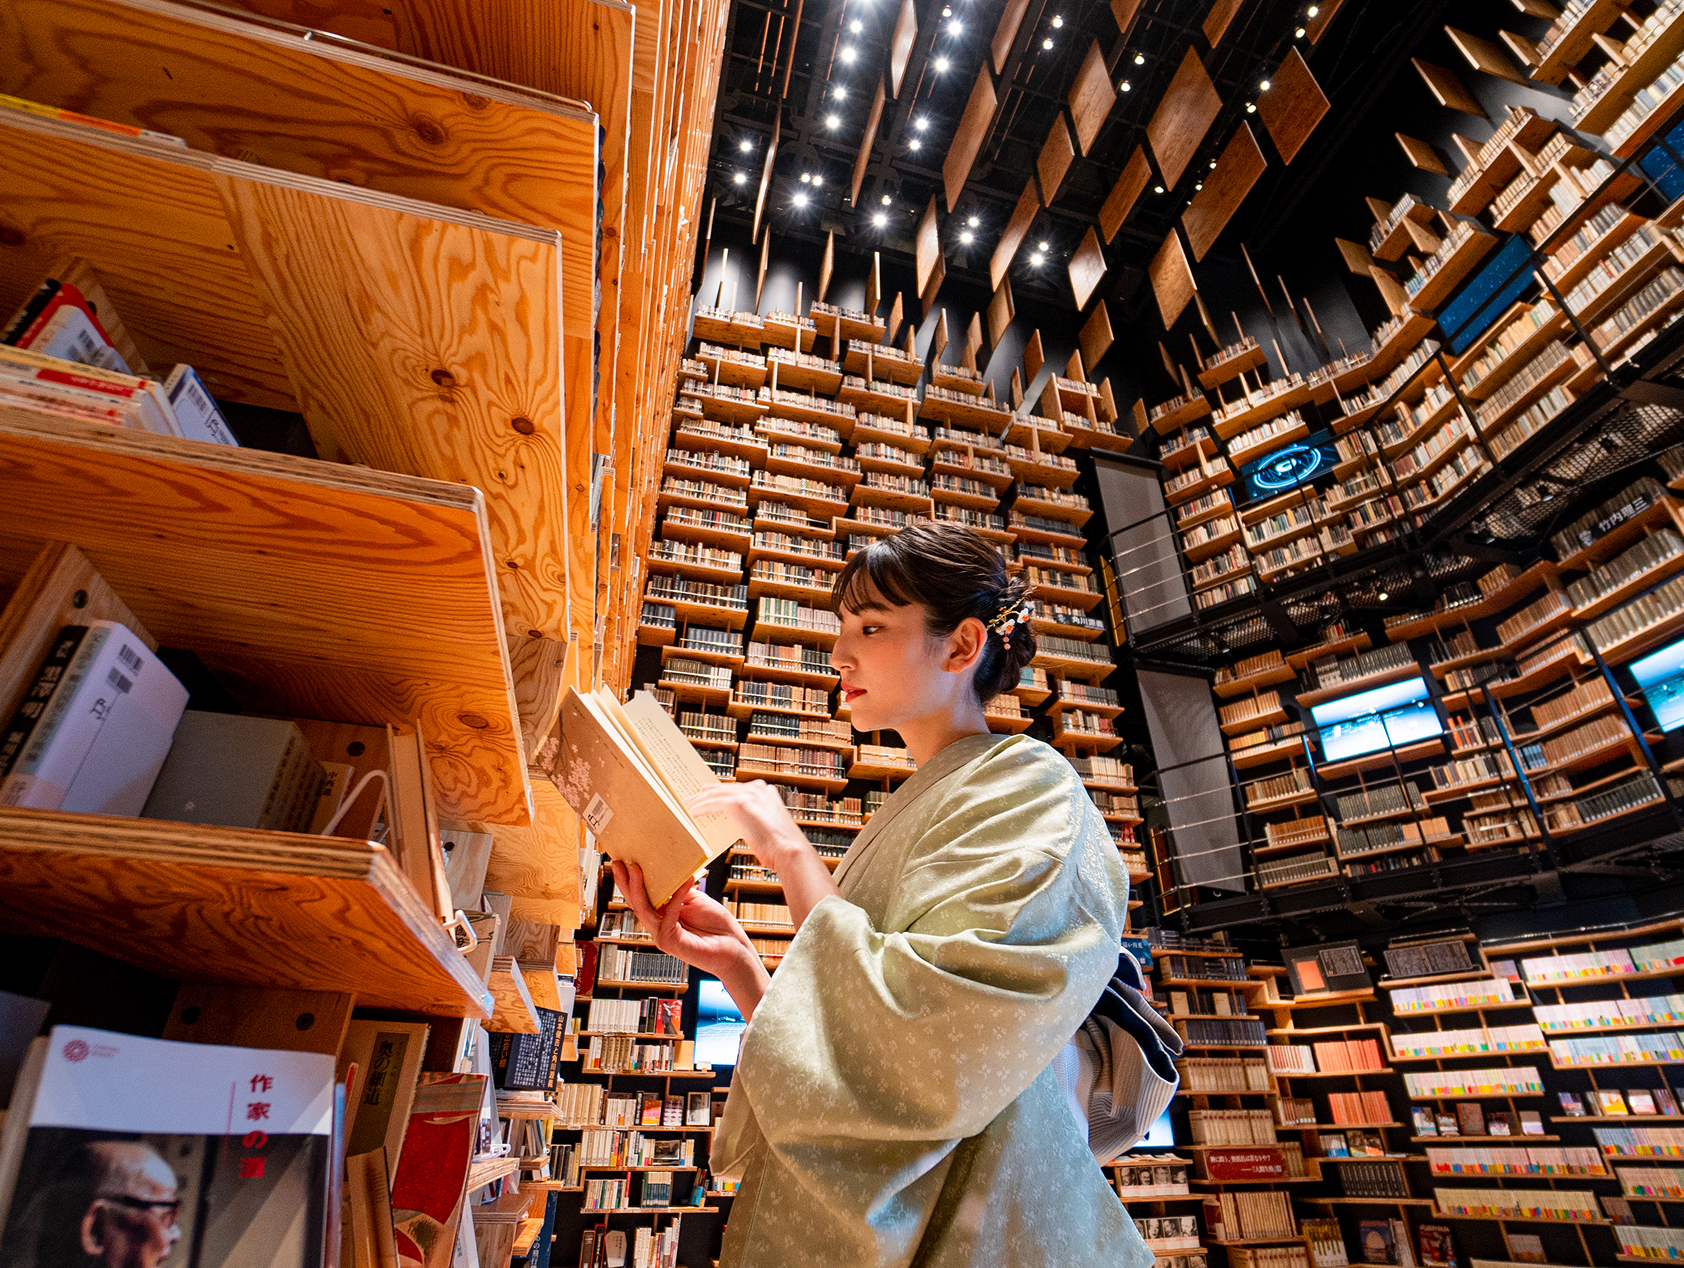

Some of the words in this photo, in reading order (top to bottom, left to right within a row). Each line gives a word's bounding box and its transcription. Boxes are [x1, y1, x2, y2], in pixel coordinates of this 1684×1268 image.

[1598, 496, 1648, 533] 竹内理三
[363, 1039, 394, 1107] 奥の細道
